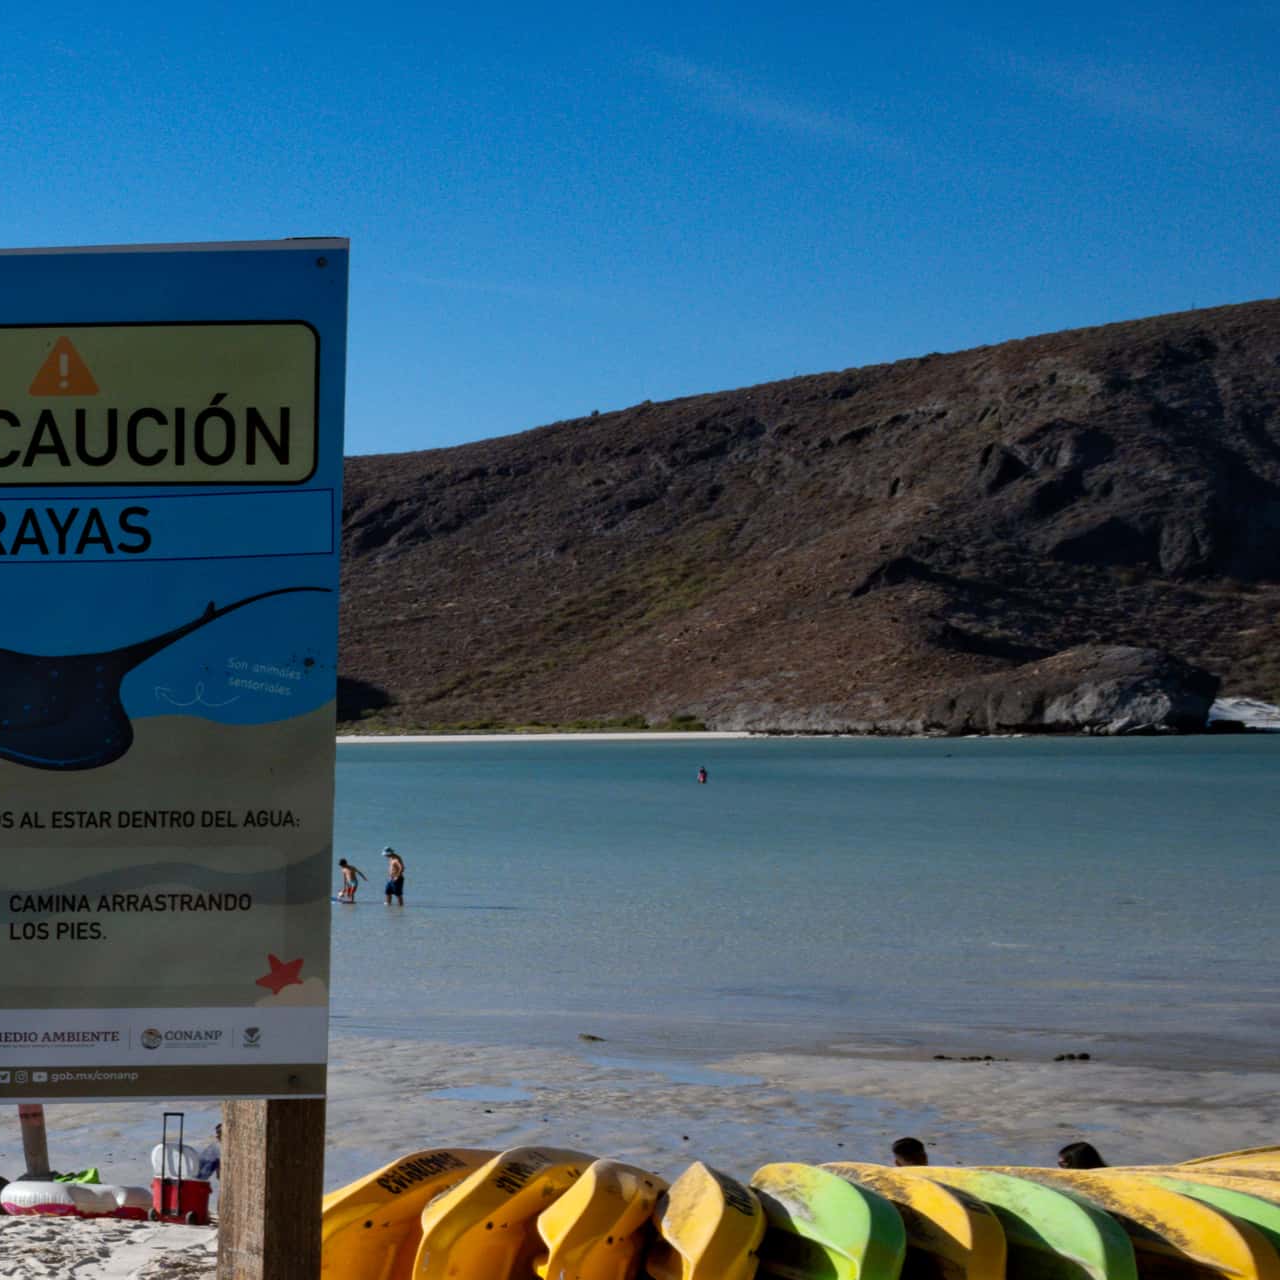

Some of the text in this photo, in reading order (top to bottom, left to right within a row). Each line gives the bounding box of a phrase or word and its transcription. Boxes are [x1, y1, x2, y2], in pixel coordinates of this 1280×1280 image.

[19, 811, 46, 829] AL
[51, 810, 112, 829] ESTAR
[117, 810, 195, 829] DENTRO
[201, 810, 238, 828] DEL
[242, 810, 300, 828] AGUA:
[9, 893, 252, 913] CAMINA ARRASTRANDO
[9, 921, 106, 941] LOS PIES.
[41, 1031, 120, 1043] AMBIENTE
[164, 1030, 223, 1041] CONANP
[50, 1069, 139, 1083] gob.mx/conanp
